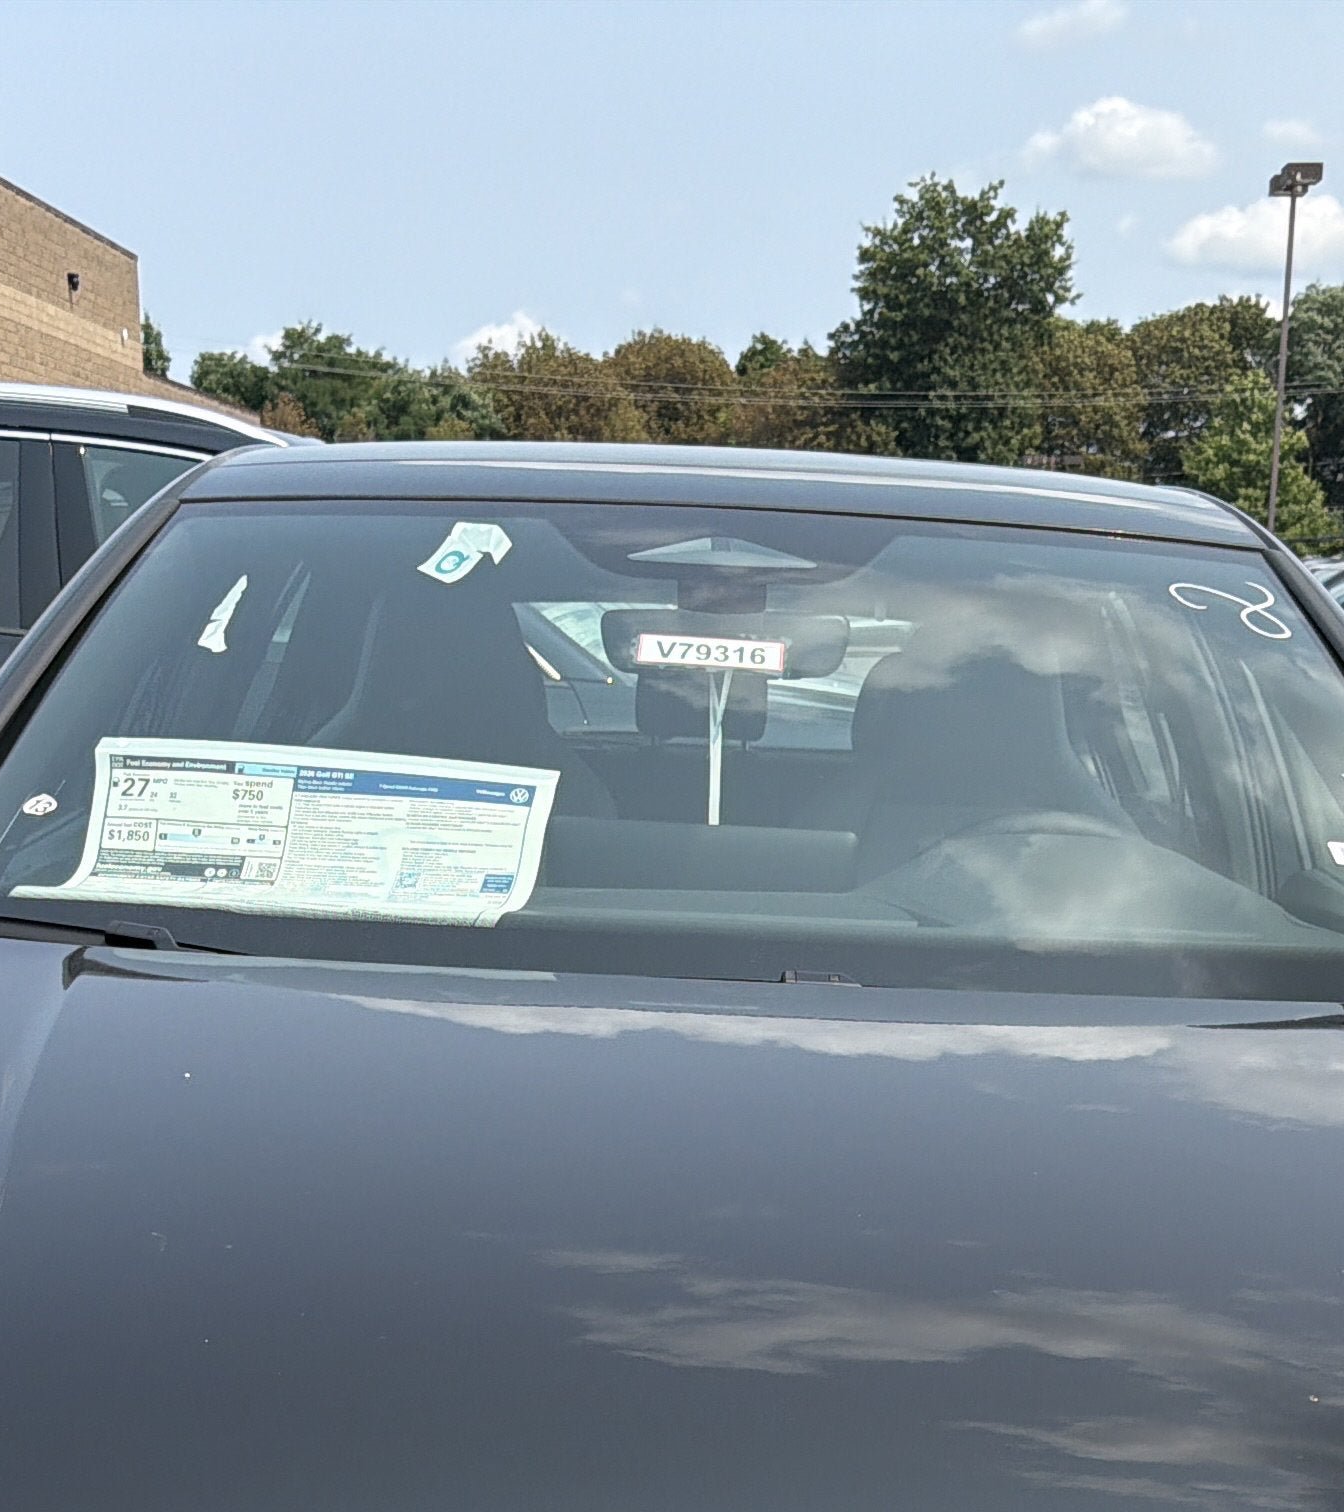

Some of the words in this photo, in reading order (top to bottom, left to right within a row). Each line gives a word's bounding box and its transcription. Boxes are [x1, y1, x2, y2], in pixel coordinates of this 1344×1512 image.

[656, 640, 766, 665] V79316
[121, 777, 151, 797] 27
[244, 779, 273, 790] spend
[232, 788, 264, 801] $750
[107, 828, 150, 842] $1,850
